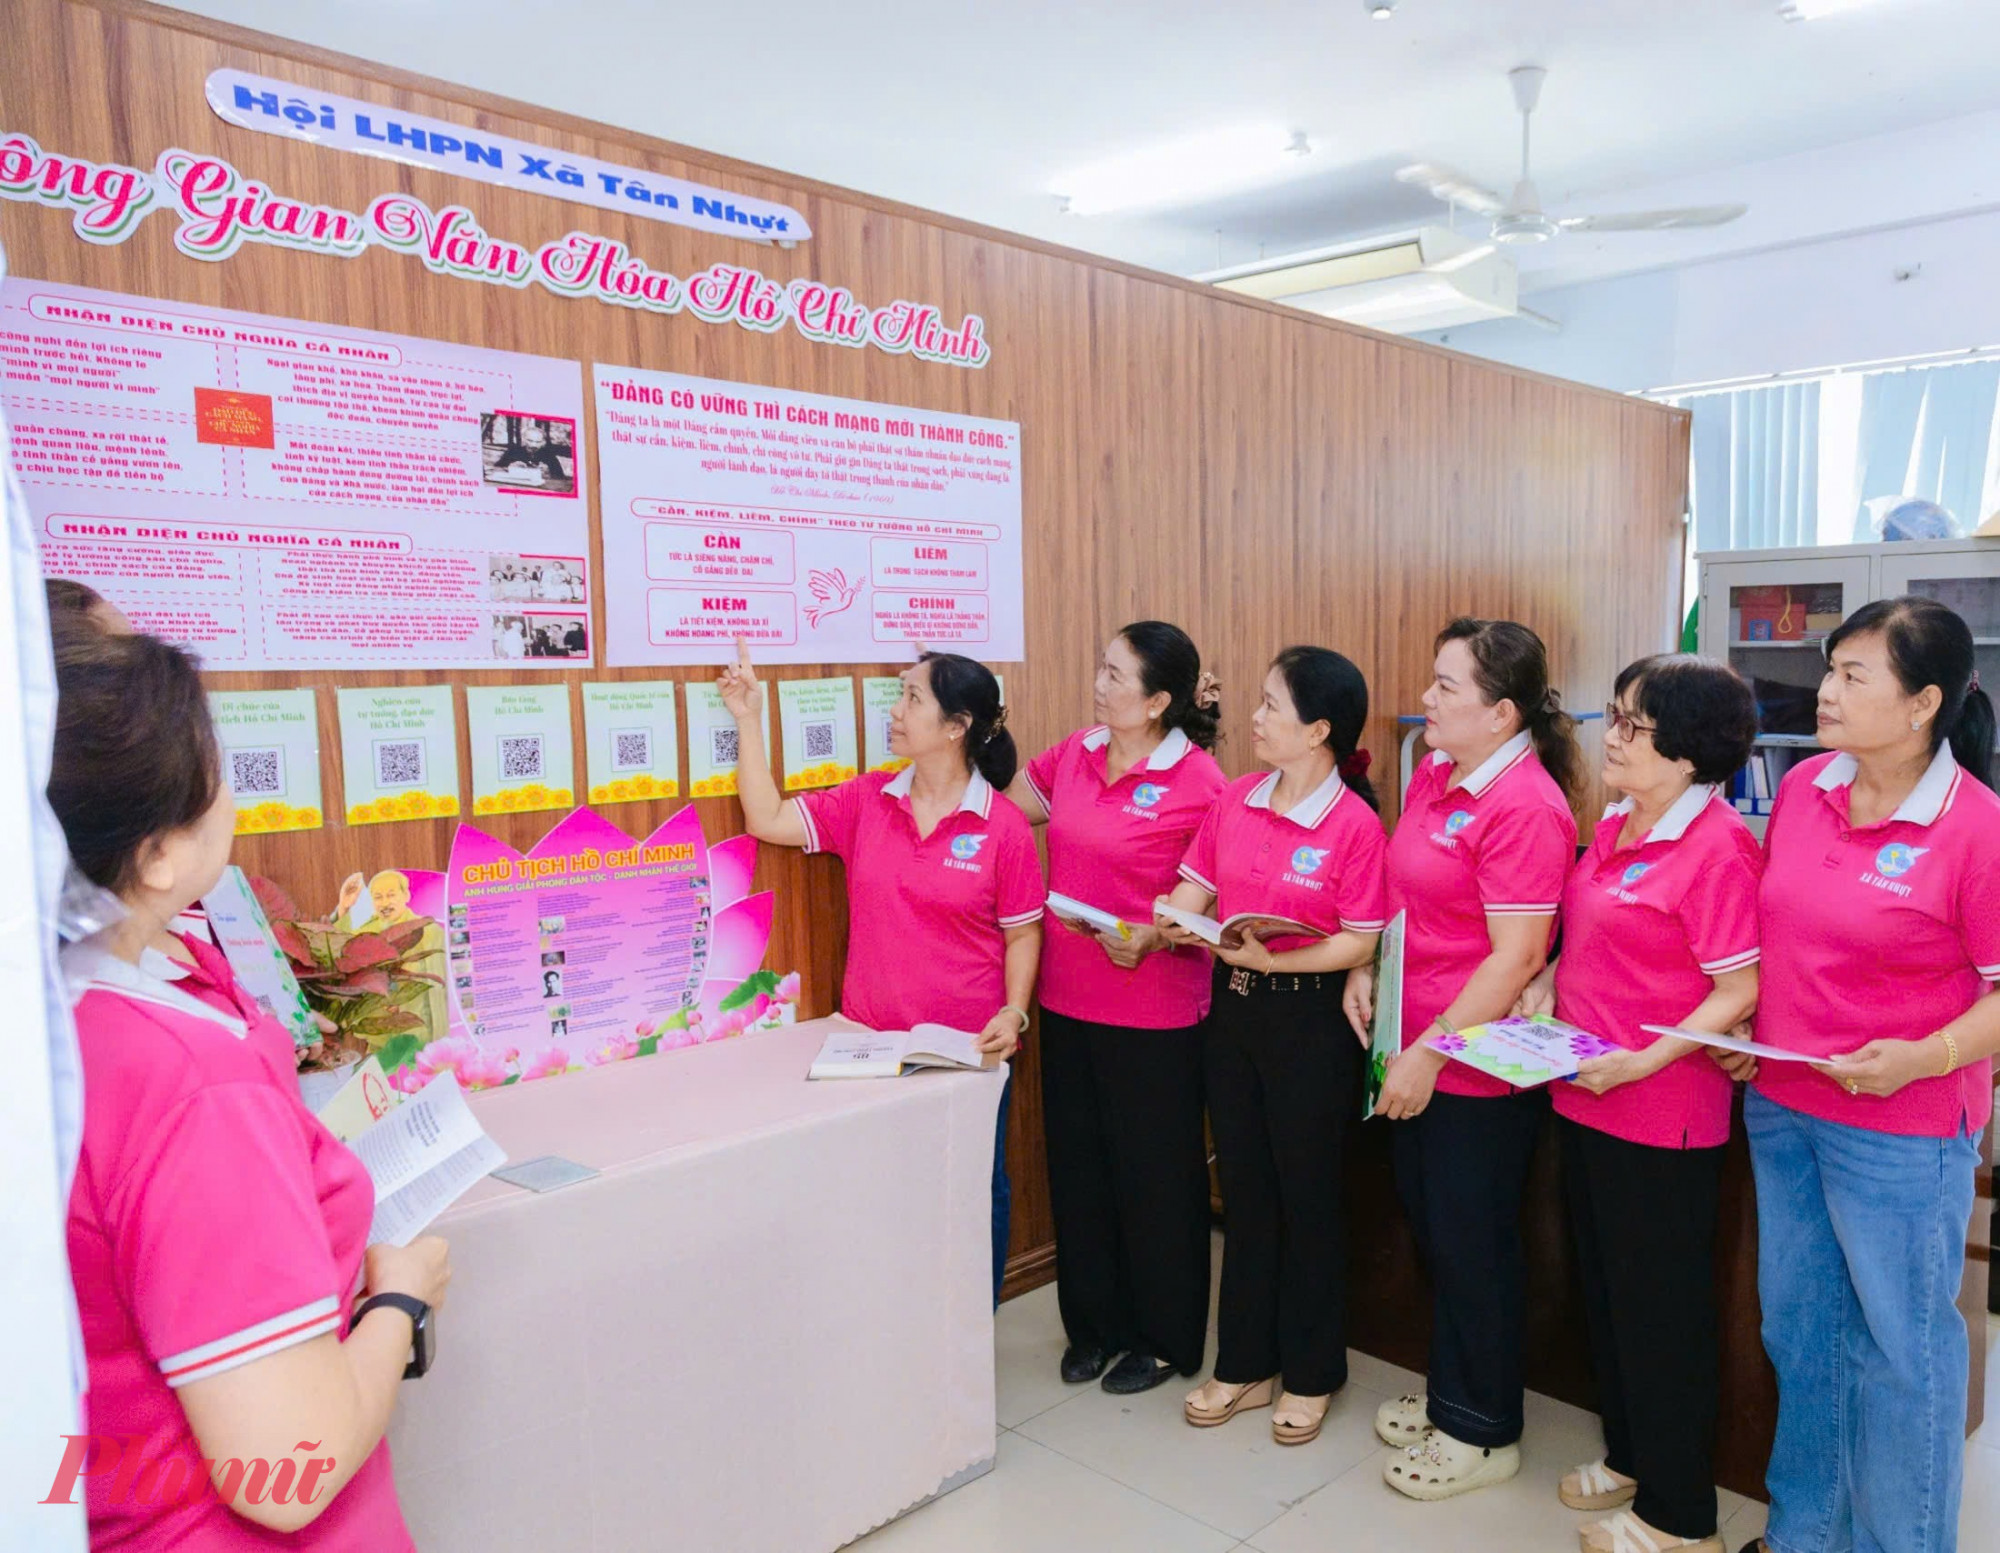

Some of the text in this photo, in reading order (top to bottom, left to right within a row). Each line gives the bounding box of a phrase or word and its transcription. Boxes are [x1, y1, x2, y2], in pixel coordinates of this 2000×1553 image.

[233, 84, 789, 232] Hội LHPN Xã Tân Nhựt
[165, 155, 357, 245] Gian
[374, 198, 526, 274] Văn
[540, 237, 677, 302] Hóa
[689, 267, 776, 321] Hồ
[791, 281, 862, 338] Chí
[873, 302, 982, 359] Minh
[46, 305, 389, 361] NHẬN DIỆN CHỦ NGHĨA CÁ NHÂN
[601, 380, 1014, 448] “ĐẢNG CÓ VỮNG THÌ CÁCH MẠNG MỚI THÀNH CÔNG.”
[63, 524, 400, 550] NHẬN DIỆN CHỦ NGHĨA CÁ NHÂN
[704, 535, 741, 549] CẦN
[914, 547, 948, 560] LIÊM
[702, 597, 747, 611] KIỆM
[909, 597, 955, 609] CHÍNH
[463, 843, 694, 883] CHỦ TỊCH HỒ CHÍ MINH
[1859, 872, 1912, 898] XÃ TÂN NHỰT
